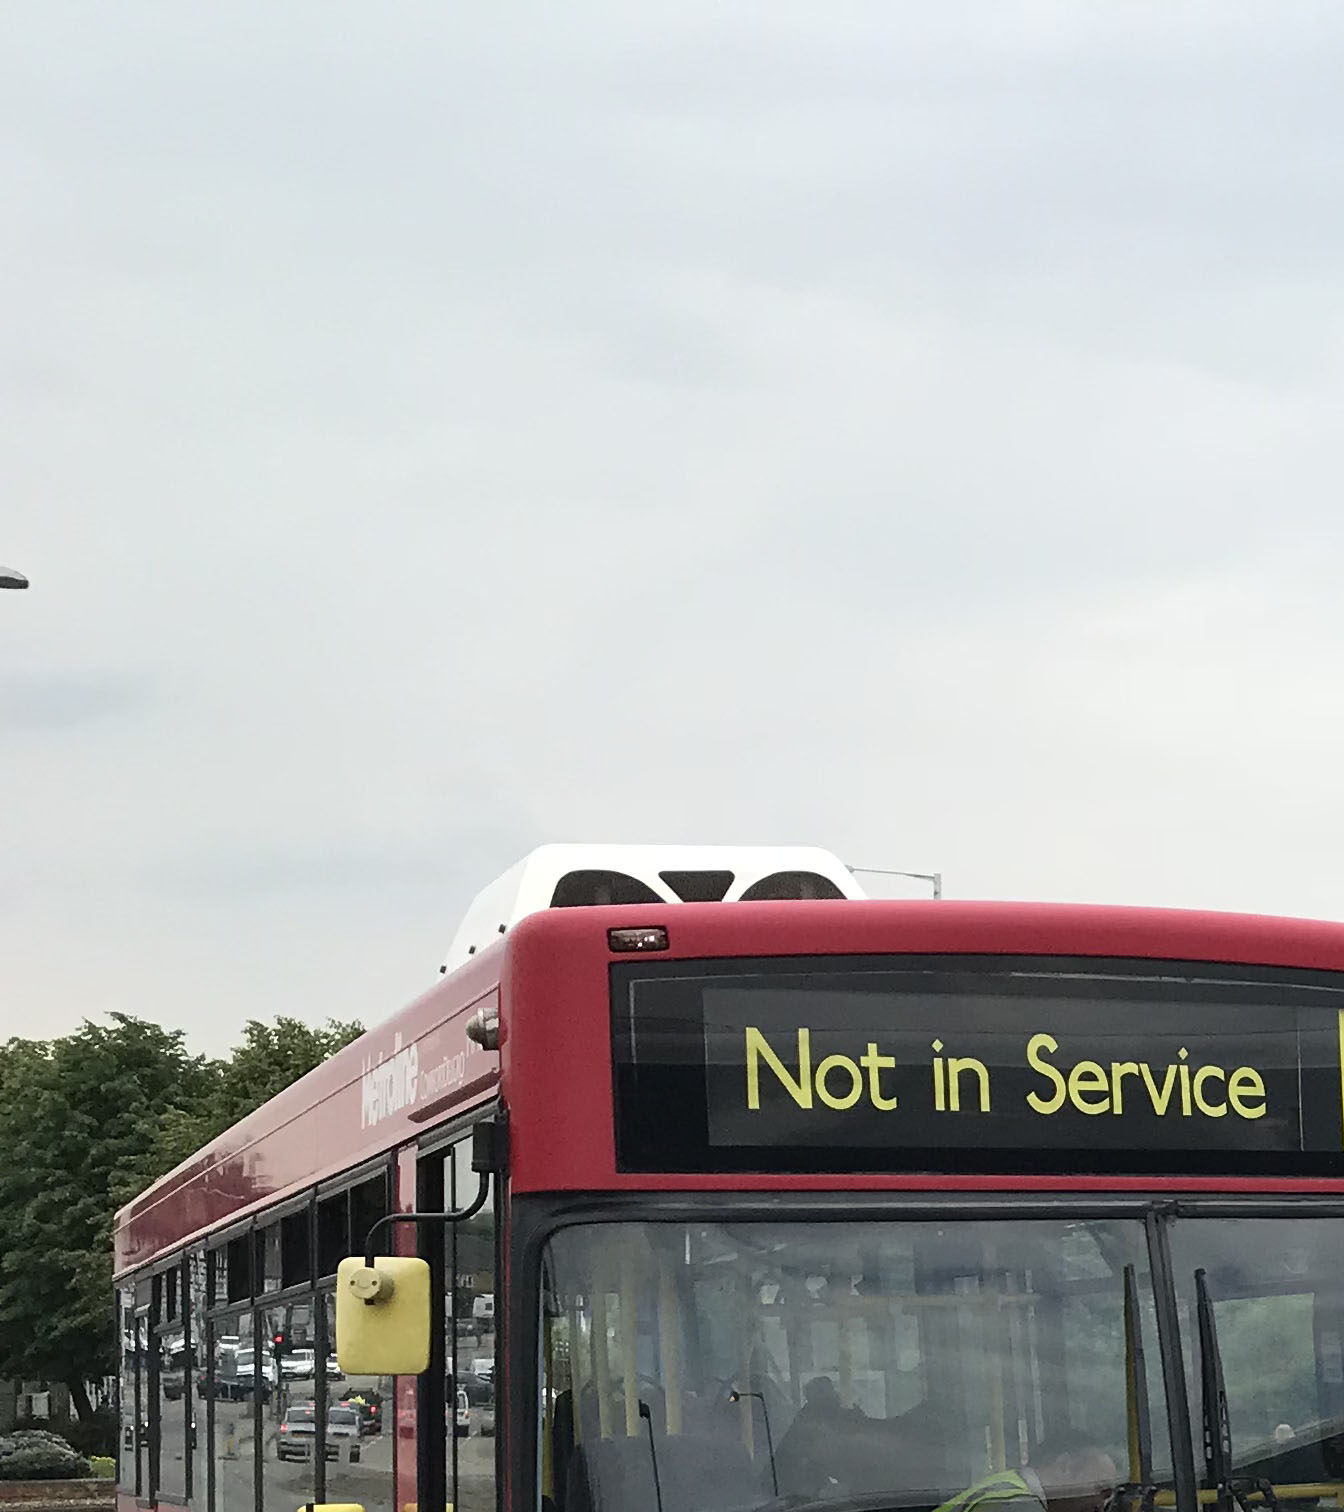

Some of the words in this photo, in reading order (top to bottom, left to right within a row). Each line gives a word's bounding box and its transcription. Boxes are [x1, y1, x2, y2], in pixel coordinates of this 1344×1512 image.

[745, 1026, 897, 1114] Not
[932, 1037, 991, 1114] in
[1026, 1032, 1268, 1121] Service
